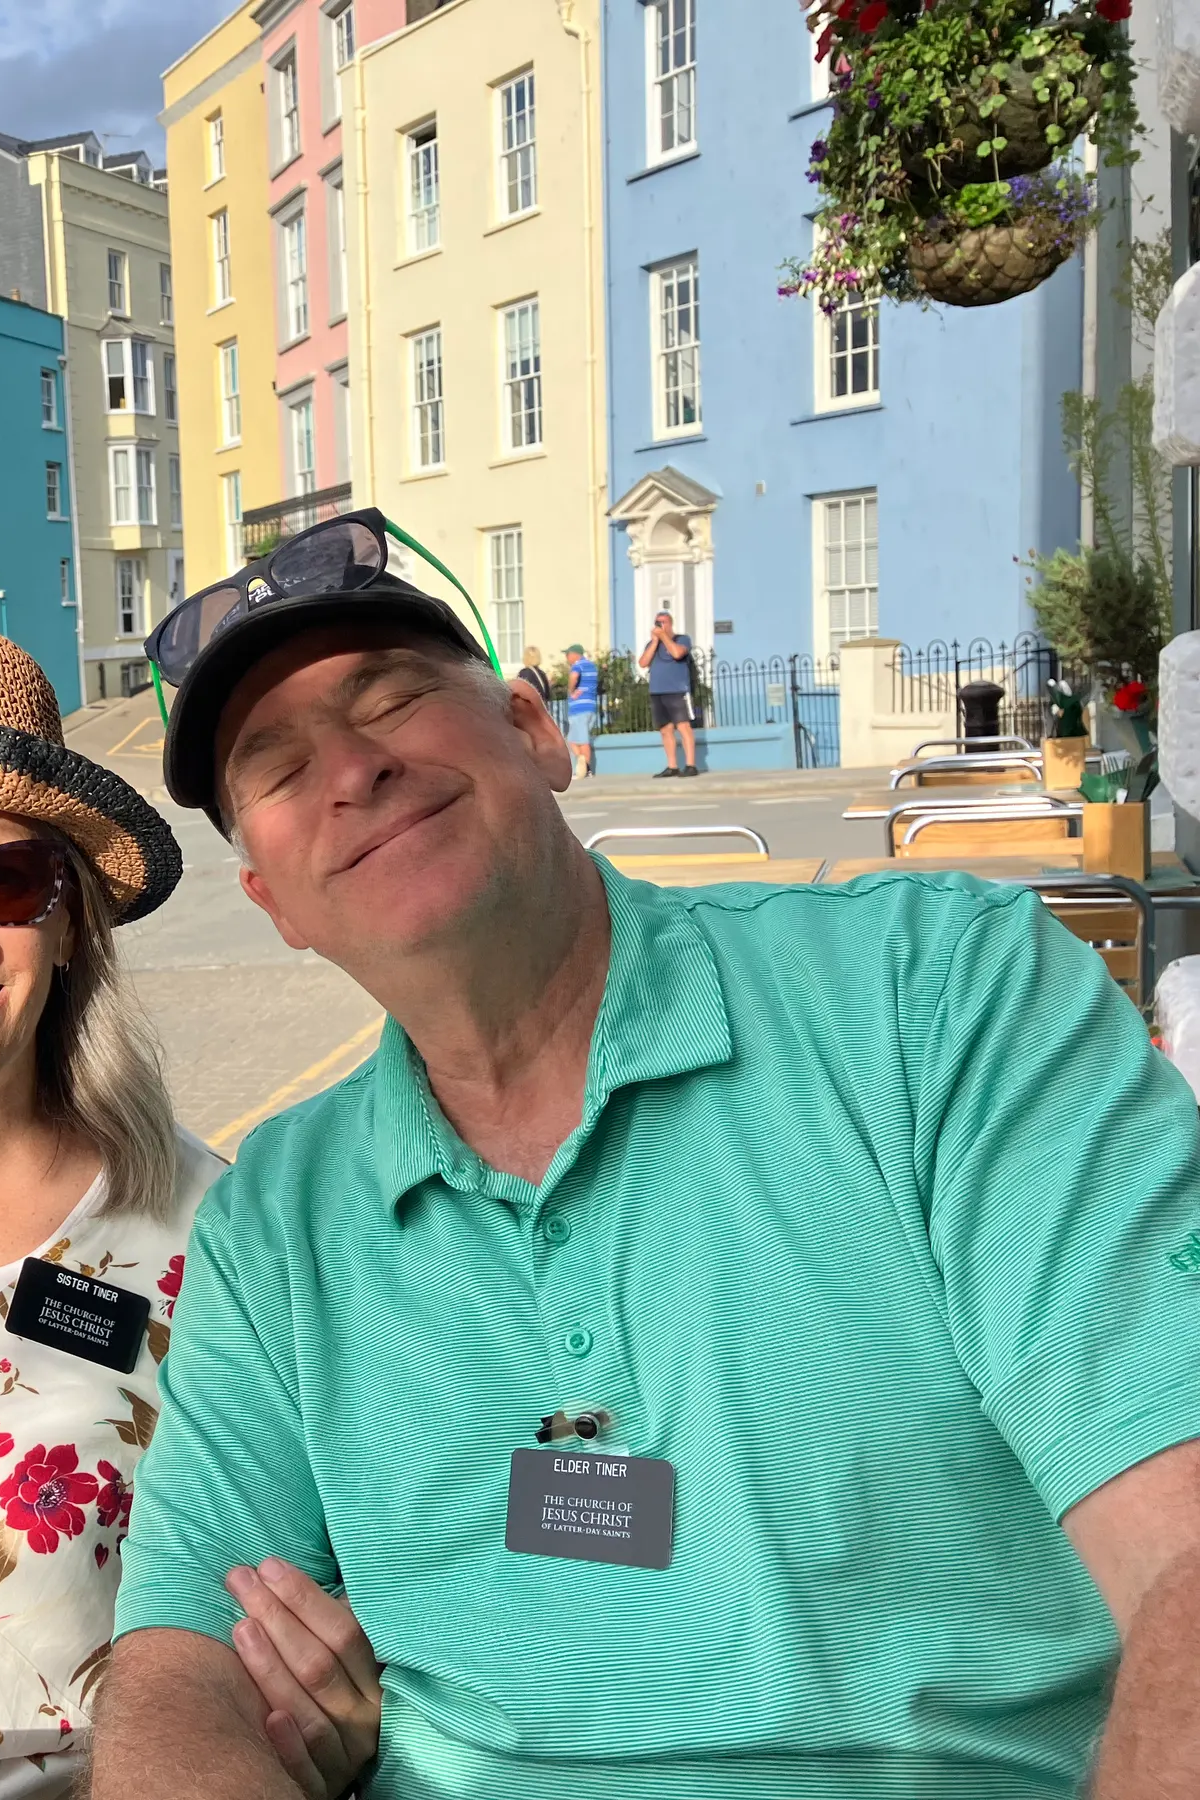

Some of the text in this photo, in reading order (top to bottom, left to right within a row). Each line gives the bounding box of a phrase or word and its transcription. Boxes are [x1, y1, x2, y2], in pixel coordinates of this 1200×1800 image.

[56, 1272, 119, 1303] SISTER TINER
[40, 1306, 114, 1339] JESUS CHRIST
[44, 1296, 116, 1328] THE CHURCH OF
[48, 1320, 87, 1339] LATTER-DAY
[86, 1334, 110, 1347] SAINTS
[554, 1458, 628, 1478] ELDER TINER
[543, 1494, 633, 1512] THE CHURCH OF
[541, 1507, 632, 1529] JESUS CHRIST
[542, 1522, 631, 1539] OF LATTER-DAY SAINTS
